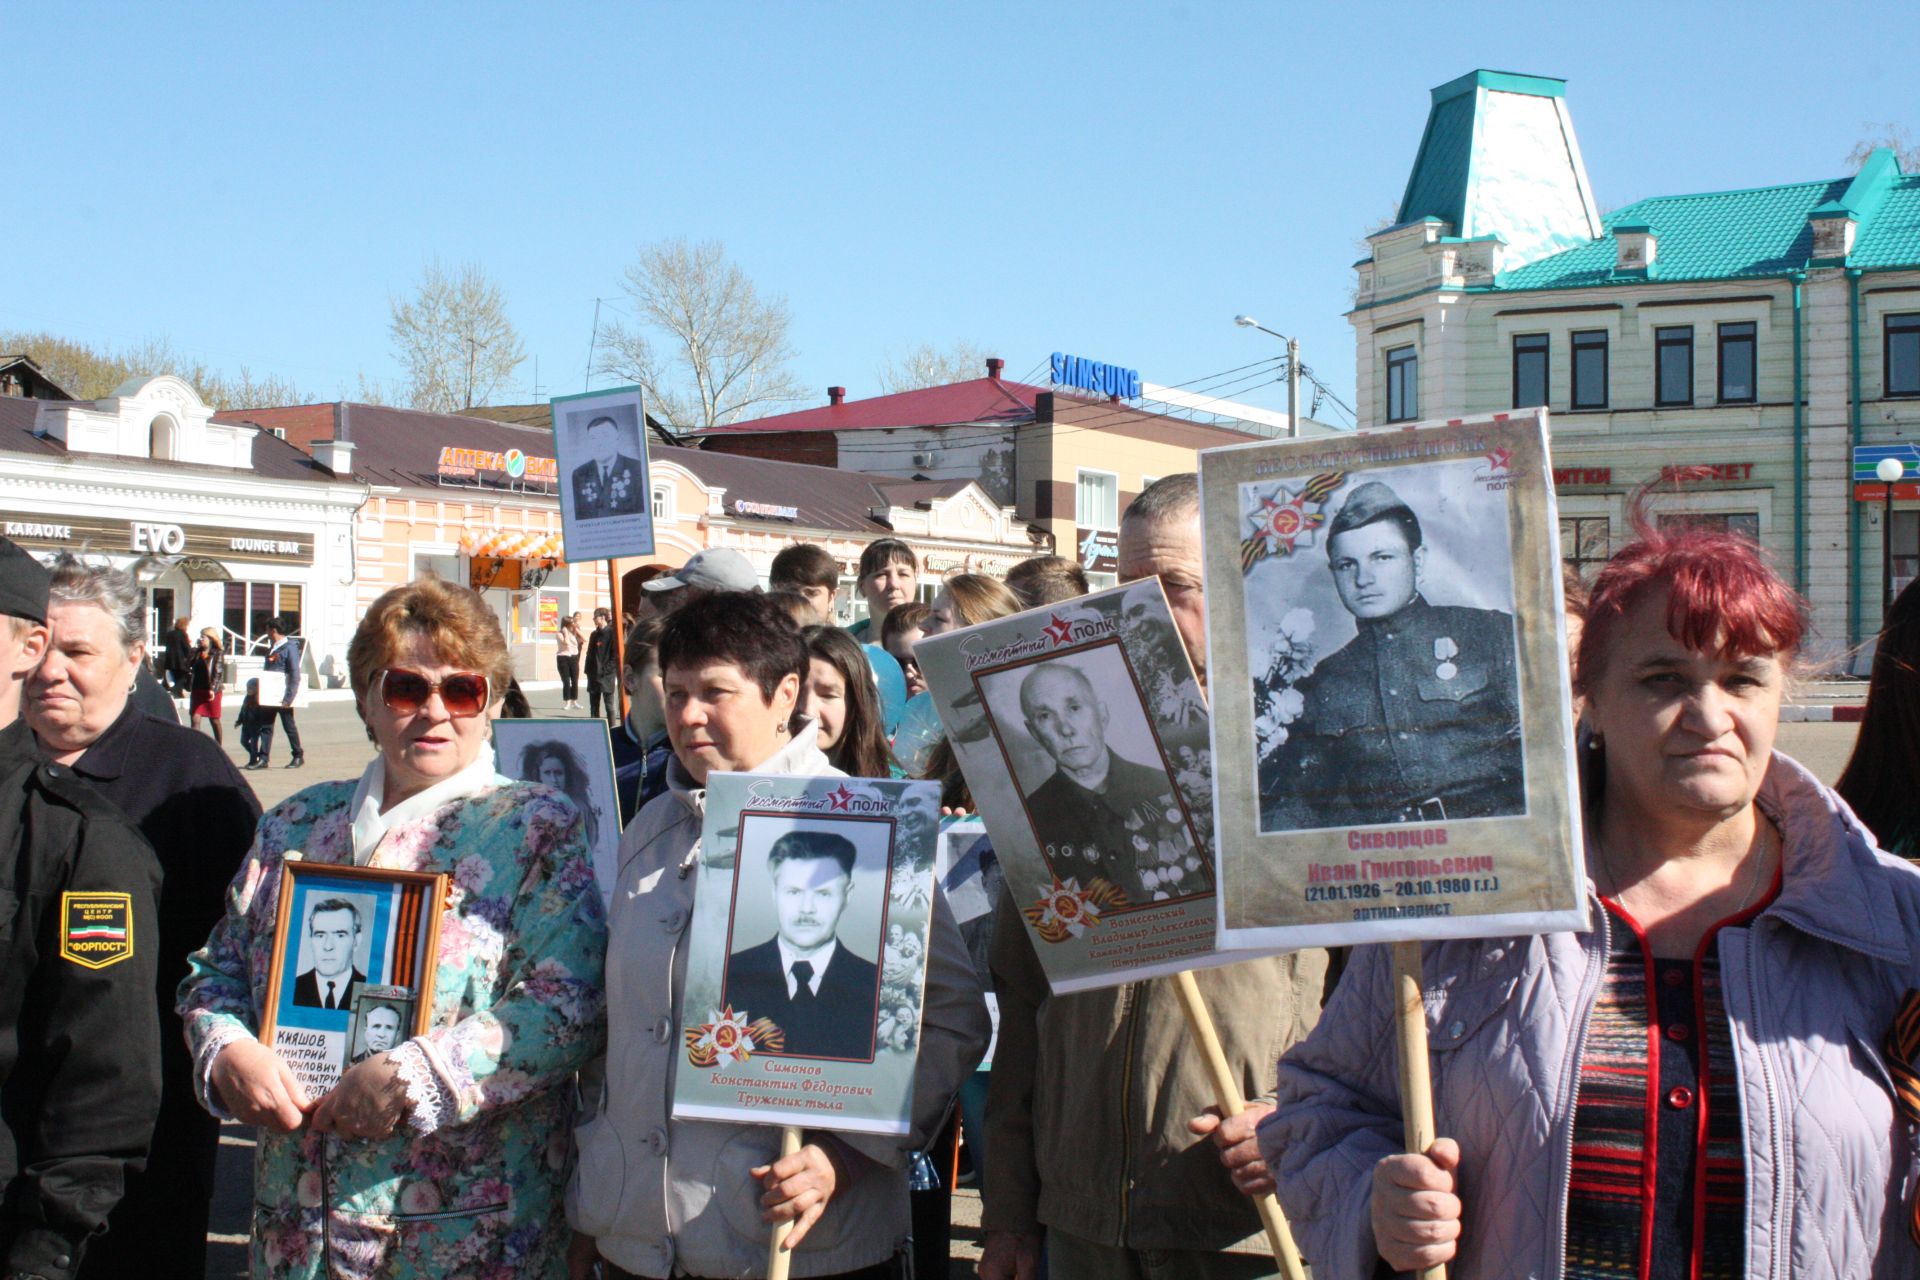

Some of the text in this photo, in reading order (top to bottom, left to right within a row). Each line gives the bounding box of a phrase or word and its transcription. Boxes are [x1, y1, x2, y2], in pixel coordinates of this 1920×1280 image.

[1051, 352, 1140, 400] SAMSUNG
[438, 446, 558, 476] АПТЕКА ВИТ
[1553, 467, 1612, 485] ИТКИ
[5, 521, 71, 539] KARAOKE
[130, 521, 186, 555] EVO
[230, 537, 300, 555] LOUNGE BAR
[1348, 828, 1448, 850] Скворцов
[1307, 855, 1494, 883] Иван Григорьевич
[1304, 883, 1381, 902] (21.01.1926
[1395, 878, 1471, 897] 20.10.1980
[1353, 902, 1451, 922] артиллерист
[764, 1060, 822, 1076] Симонов
[711, 1073, 873, 1098] Константин Фёдорович
[737, 1091, 844, 1111] Труженик тыла
